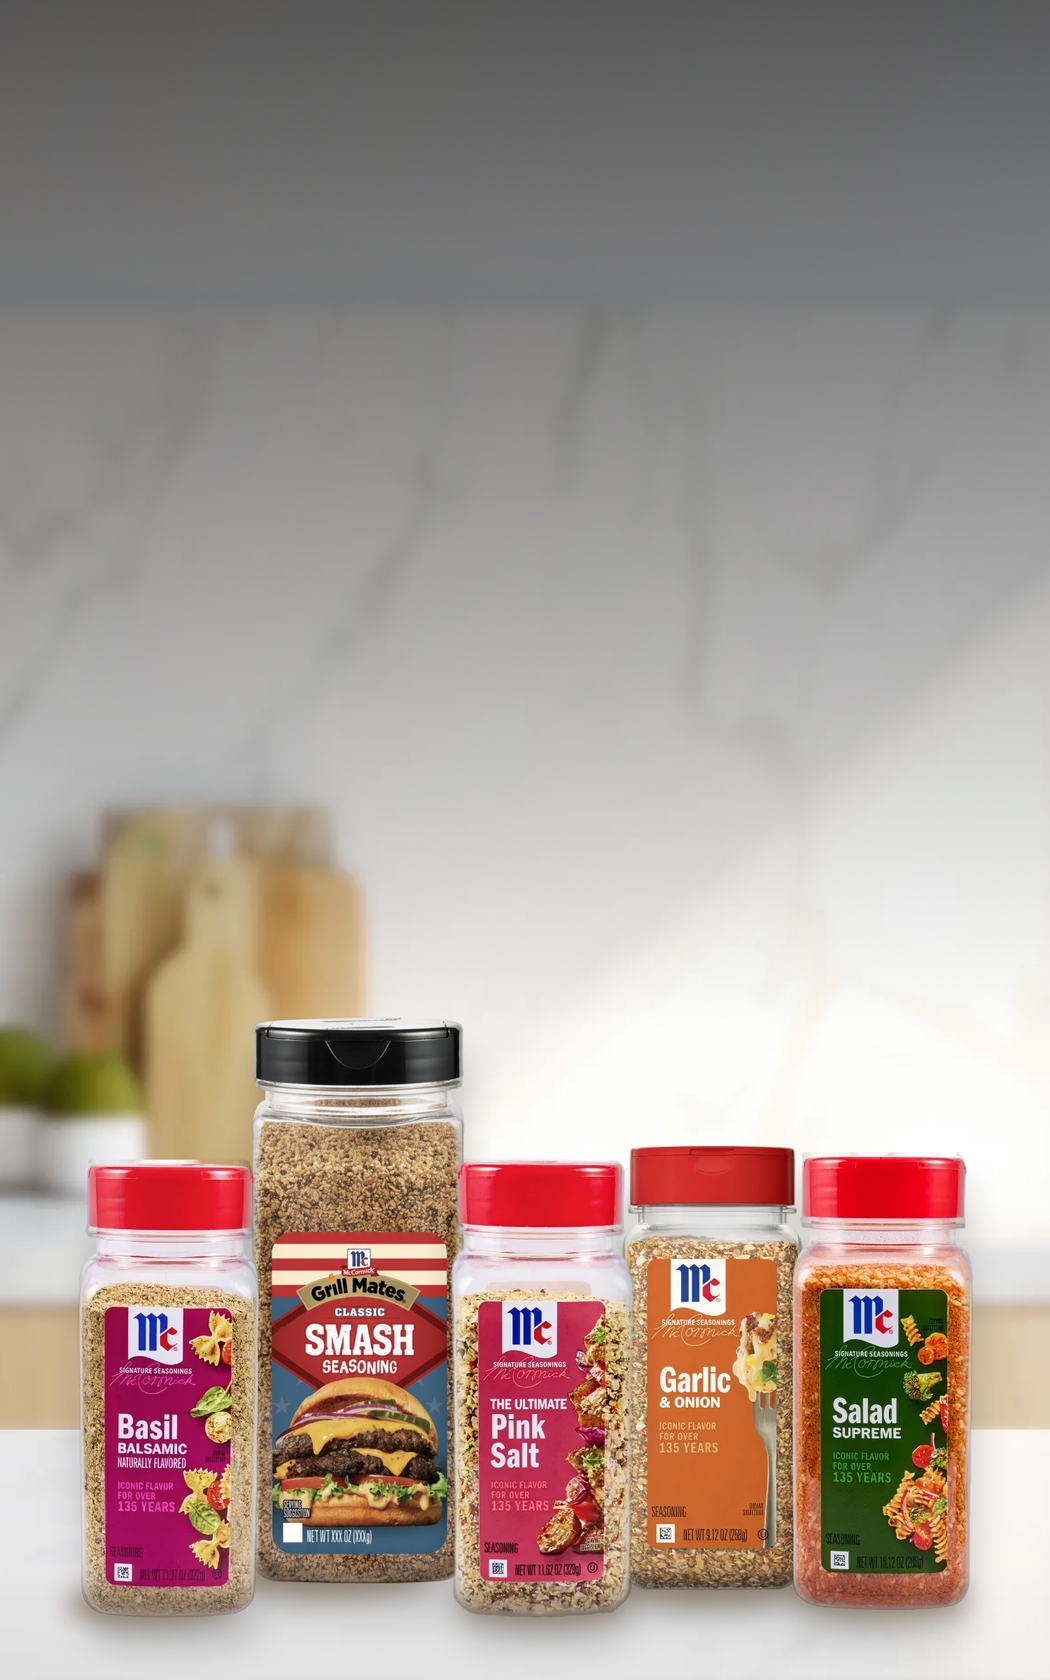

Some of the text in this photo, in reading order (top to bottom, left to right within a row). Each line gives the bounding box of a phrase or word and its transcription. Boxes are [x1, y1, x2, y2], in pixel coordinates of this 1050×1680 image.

[343, 1268, 375, 1276] McCormick
[311, 1278, 406, 1302] Grill Mates
[335, 1308, 385, 1317] CLASSIC
[652, 1313, 739, 1346] McCormick
[305, 1323, 414, 1356] SMASH
[322, 1359, 398, 1374] SEASONING
[483, 1356, 570, 1388] McCormick
[660, 1366, 731, 1393] Garlic
[490, 1398, 567, 1410] THE ULTIMATE
[659, 1396, 720, 1408] & ONION
[832, 1397, 897, 1424] Salad
[118, 1414, 178, 1440] Basil
[492, 1414, 546, 1439] Pink
[660, 1422, 716, 1430] ICONIC FLAVOR
[660, 1432, 698, 1440] FOR OVER
[832, 1427, 901, 1439] SUPREME
[118, 1443, 187, 1454] BALSAMIC
[660, 1442, 718, 1453] 135 YEARS
[490, 1442, 539, 1468] Salt
[832, 1452, 889, 1460] ICONIC FLAVOR
[118, 1457, 186, 1469] NATURALLY FLAVORED
[833, 1462, 871, 1470] FOR OVER
[833, 1472, 891, 1483] 135 YEARS
[118, 1482, 173, 1490] ICONIC FLAVOR
[491, 1481, 547, 1489] ICONIC FLAVOR
[118, 1492, 156, 1500] FOR OVER
[491, 1491, 529, 1499] FOR OVER
[118, 1501, 175, 1512] 135 YEARS
[491, 1501, 549, 1511] 135 YEARS
[652, 1506, 686, 1518] SEASONING
[306, 1530, 318, 1543] NET
[320, 1530, 330, 1543] WT
[344, 1530, 352, 1543] OZ
[683, 1529, 694, 1541] NET
[695, 1529, 705, 1541] WT
[720, 1529, 728, 1541] OZ
[826, 1533, 860, 1545] SEASONING
[484, 1542, 518, 1554] SEASONING
[515, 1564, 526, 1576] NET
[527, 1564, 536, 1576] WT
[555, 1564, 562, 1576] OZ
